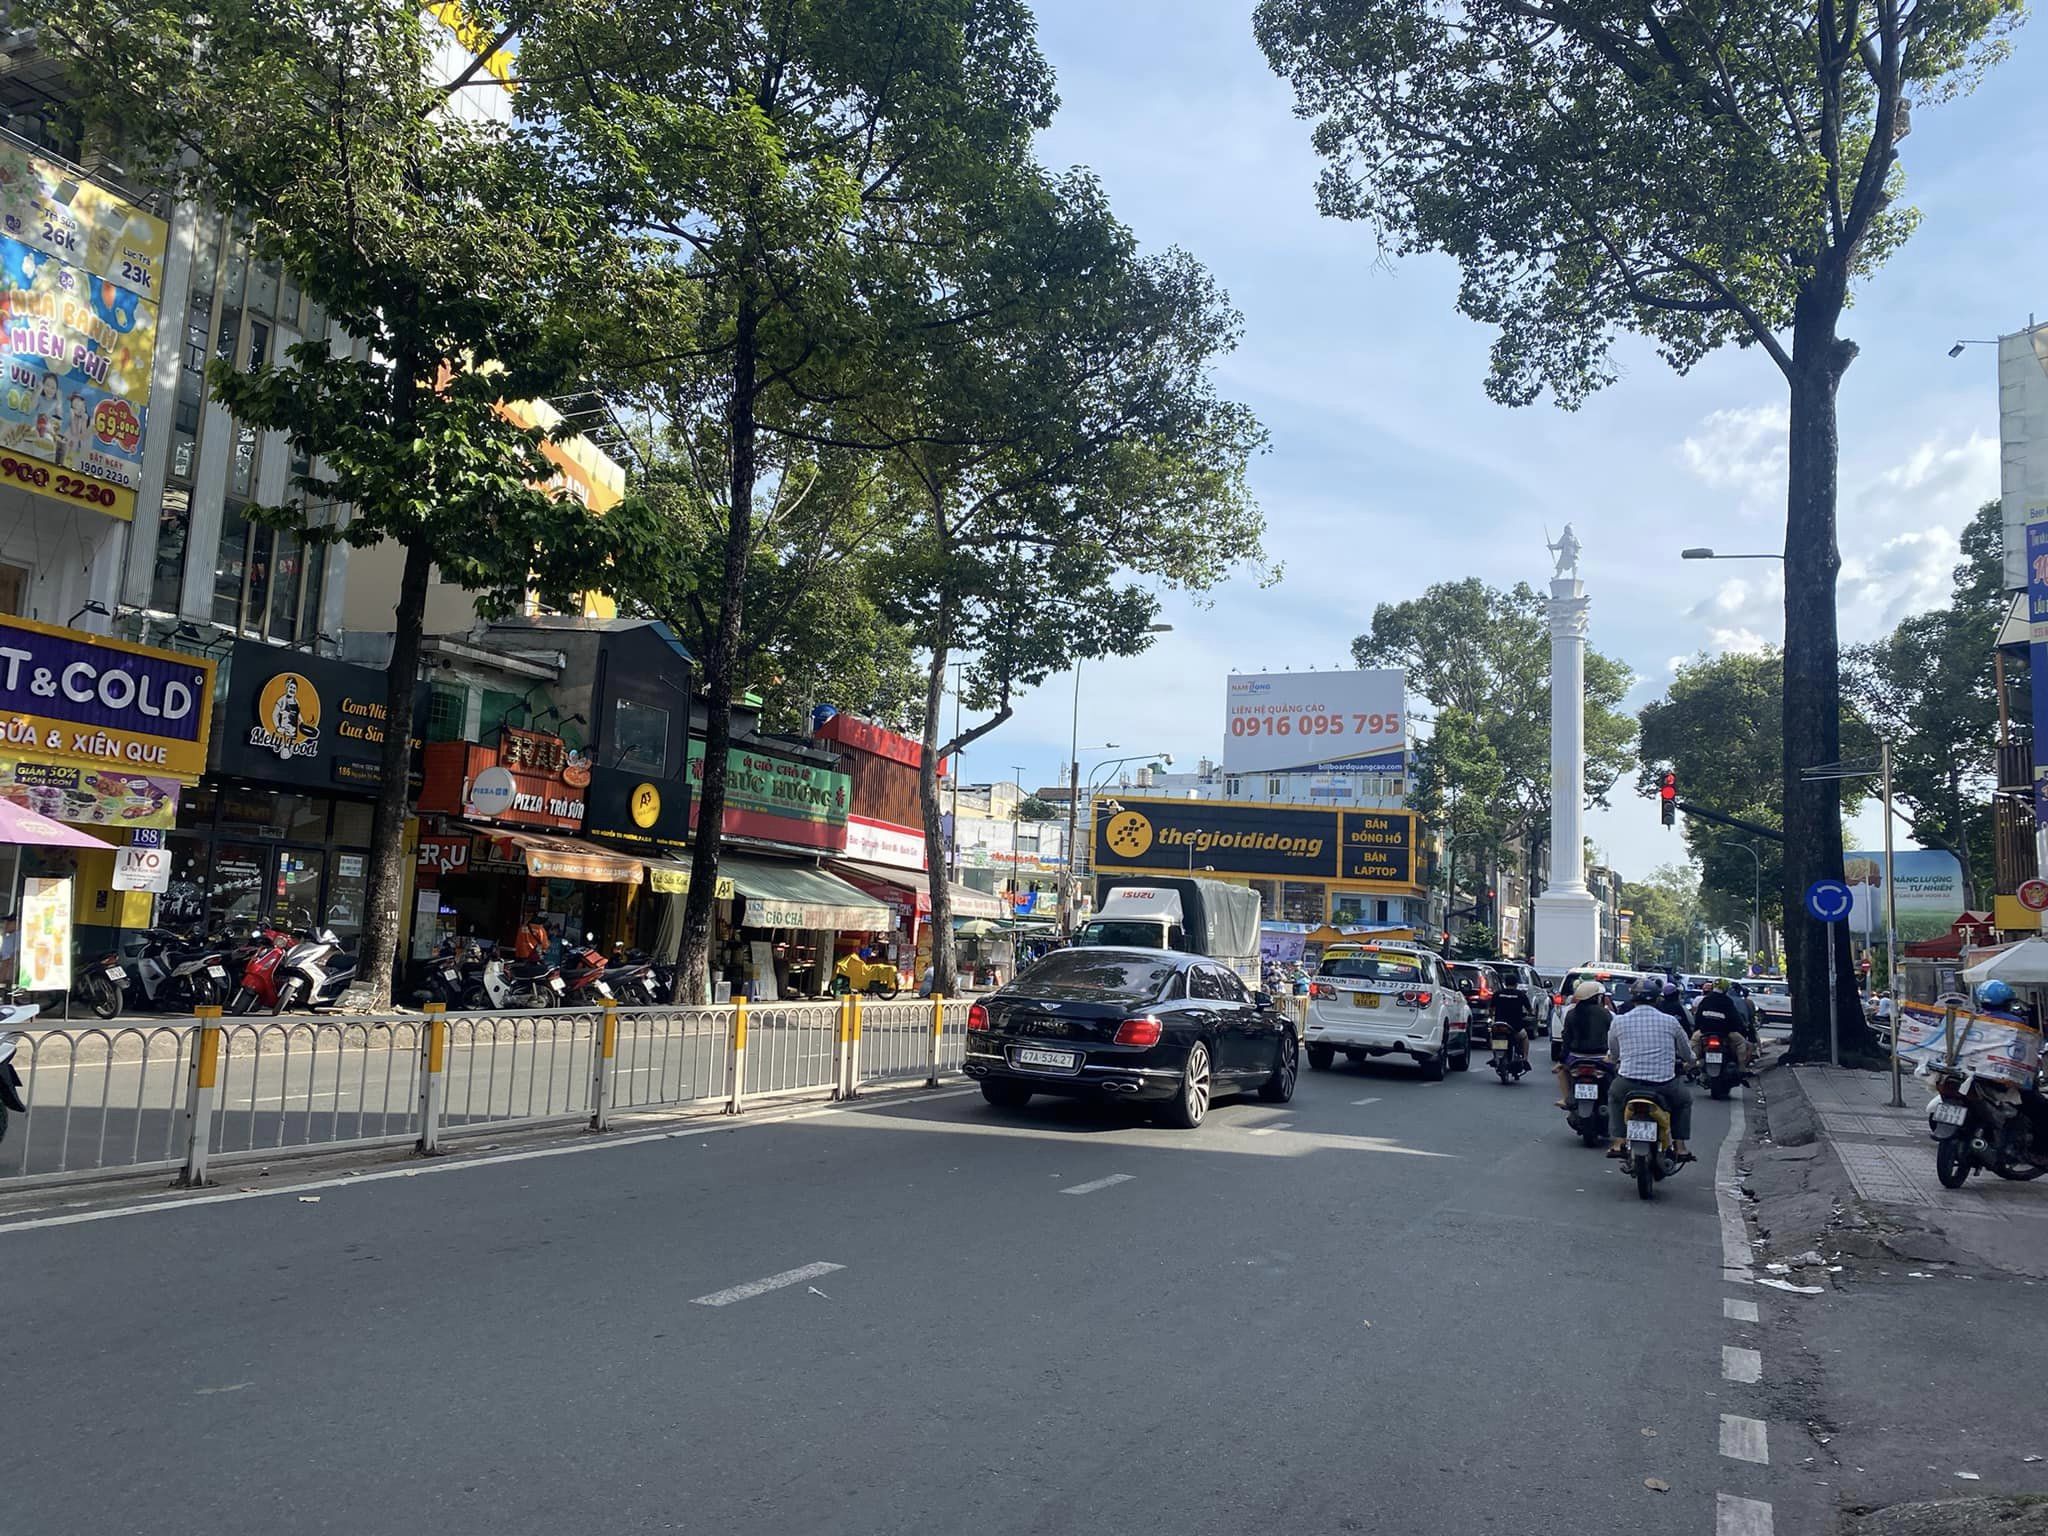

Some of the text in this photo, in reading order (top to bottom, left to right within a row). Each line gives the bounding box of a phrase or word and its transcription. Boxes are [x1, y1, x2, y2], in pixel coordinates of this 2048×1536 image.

[42, 222, 76, 251] 26k
[121, 261, 152, 288] 23k
[12, 319, 111, 384] MIỄN PHÍ
[11, 365, 36, 391] VUI
[80, 461, 129, 485] 1900 2230
[56, 475, 115, 506] 2230
[1232, 704, 1251, 715] LIÊN
[1267, 702, 1302, 714] QUẢNG
[1231, 713, 1400, 737] 0916 095 795
[46, 730, 62, 749] &
[72, 731, 120, 758] XIÊN
[126, 742, 168, 764] QUE
[287, 738, 319, 758] Food
[50, 767, 77, 780] 50%
[1318, 762, 1402, 772] billboardquangcao.com
[724, 768, 765, 795] HÚC
[513, 792, 543, 814] PIZZA
[550, 797, 567, 818] TRÀ
[1365, 818, 1388, 829] BÁN
[134, 829, 158, 844] 188
[1159, 827, 1323, 858] thegioididong
[1352, 831, 1383, 843] ĐỒNG
[1364, 851, 1387, 862] BÁN
[1354, 865, 1397, 877] LAPTOP
[1121, 891, 1155, 900] ISUZU
[1315, 976, 1347, 985] VINASUN
[1022, 1050, 1072, 1067] 47A-534.27
